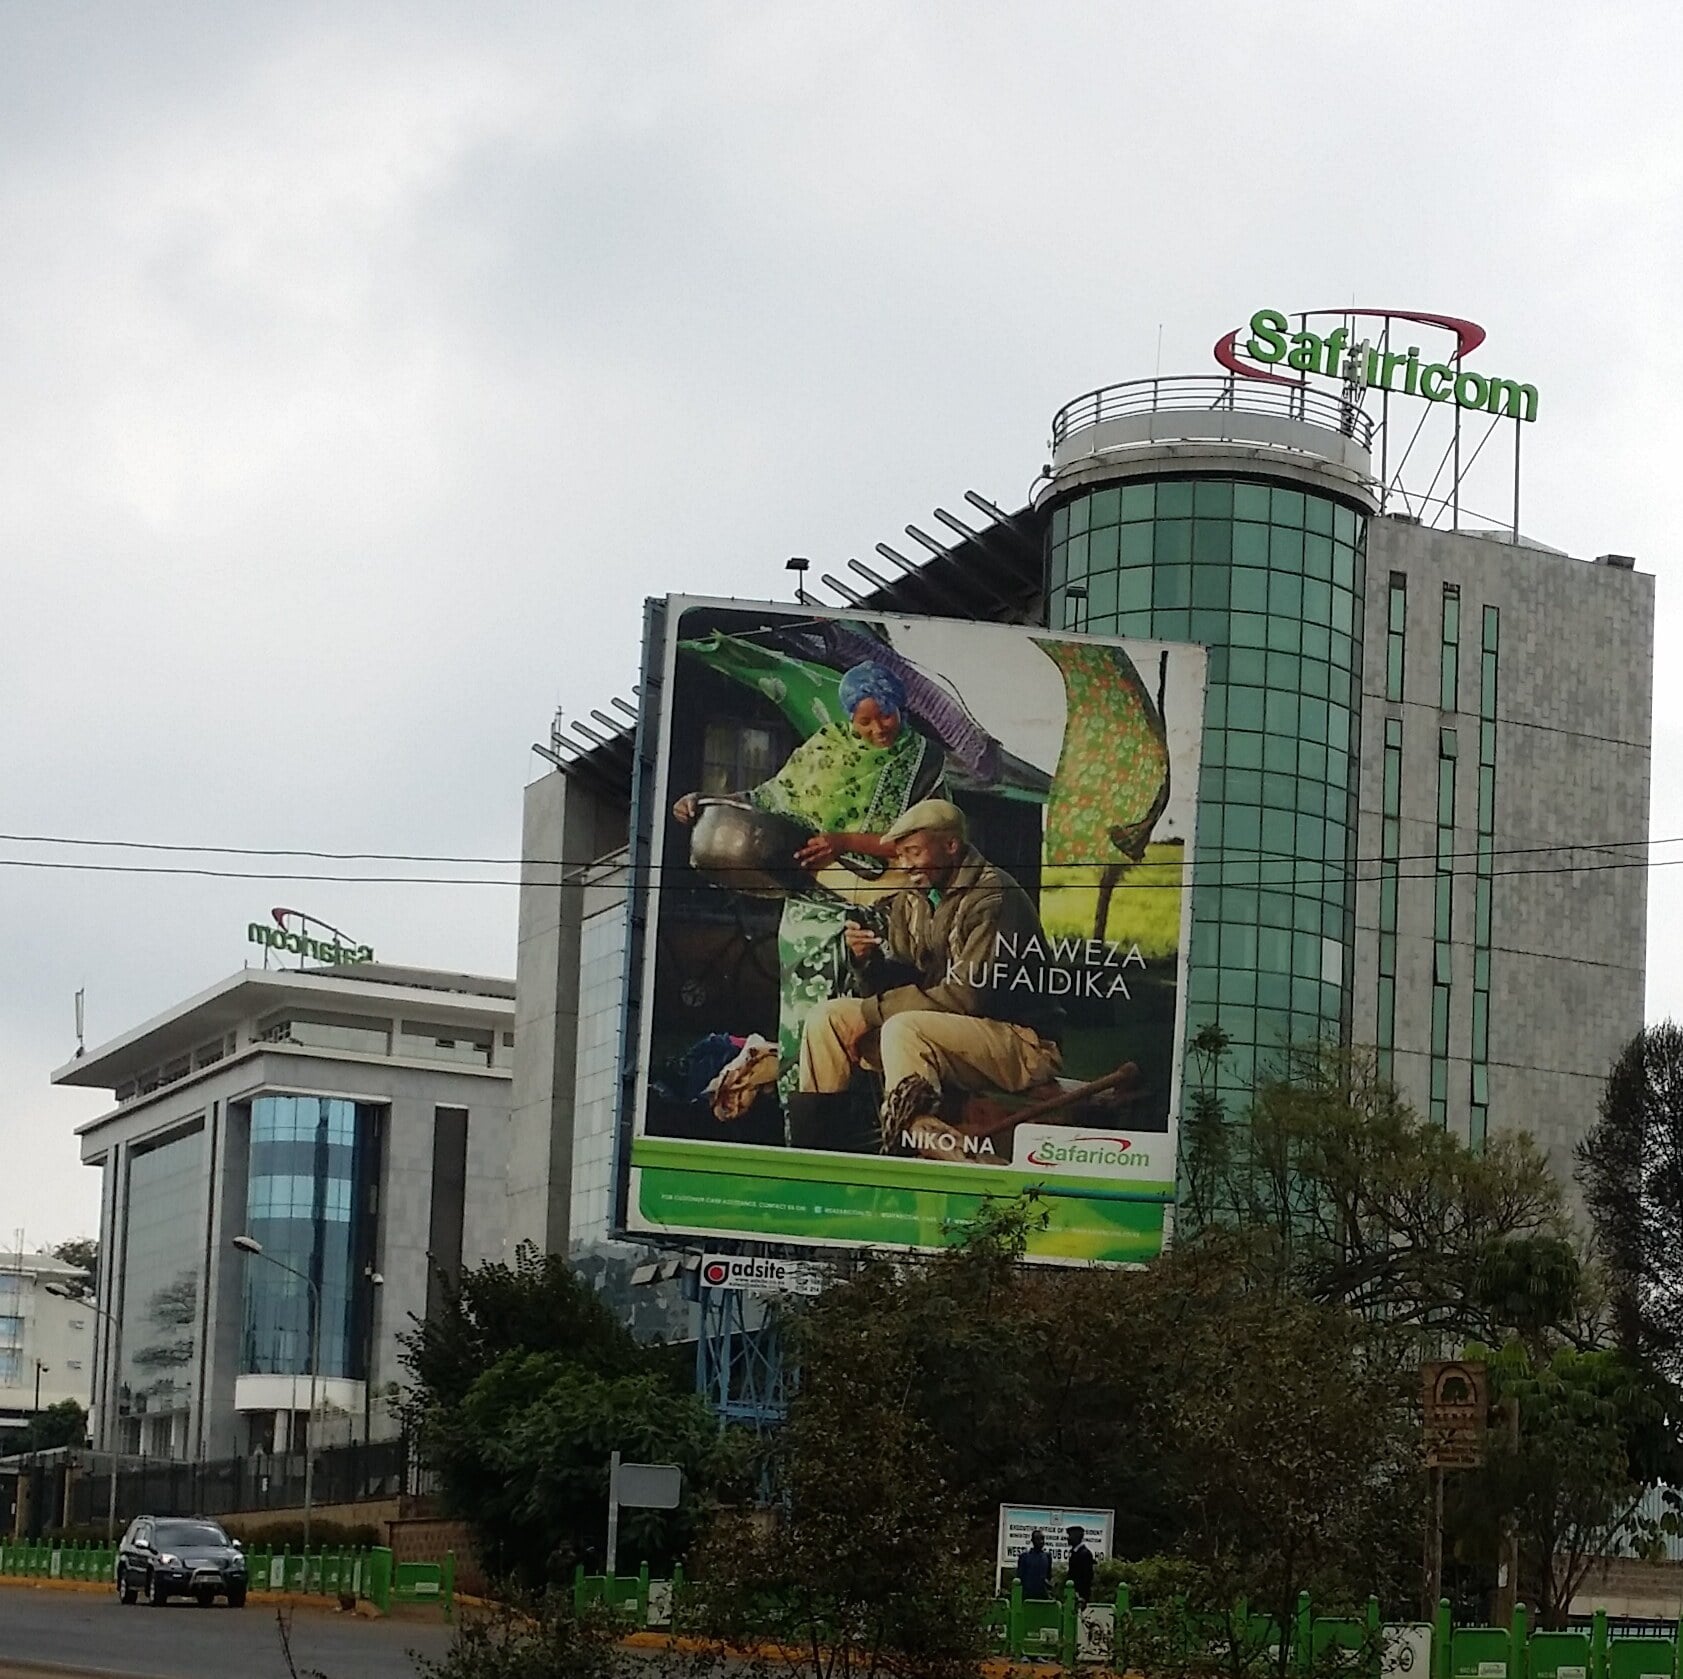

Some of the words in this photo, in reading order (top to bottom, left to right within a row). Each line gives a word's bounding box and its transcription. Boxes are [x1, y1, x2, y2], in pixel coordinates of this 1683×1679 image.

[995, 931, 1147, 969] NAWEZA
[946, 958, 1131, 1000] KUFAIDIKA
[901, 1130, 955, 1151] NIKO
[963, 1135, 995, 1155] NA
[1041, 1142, 1149, 1167] Safaricom
[732, 1258, 786, 1279] adsite
